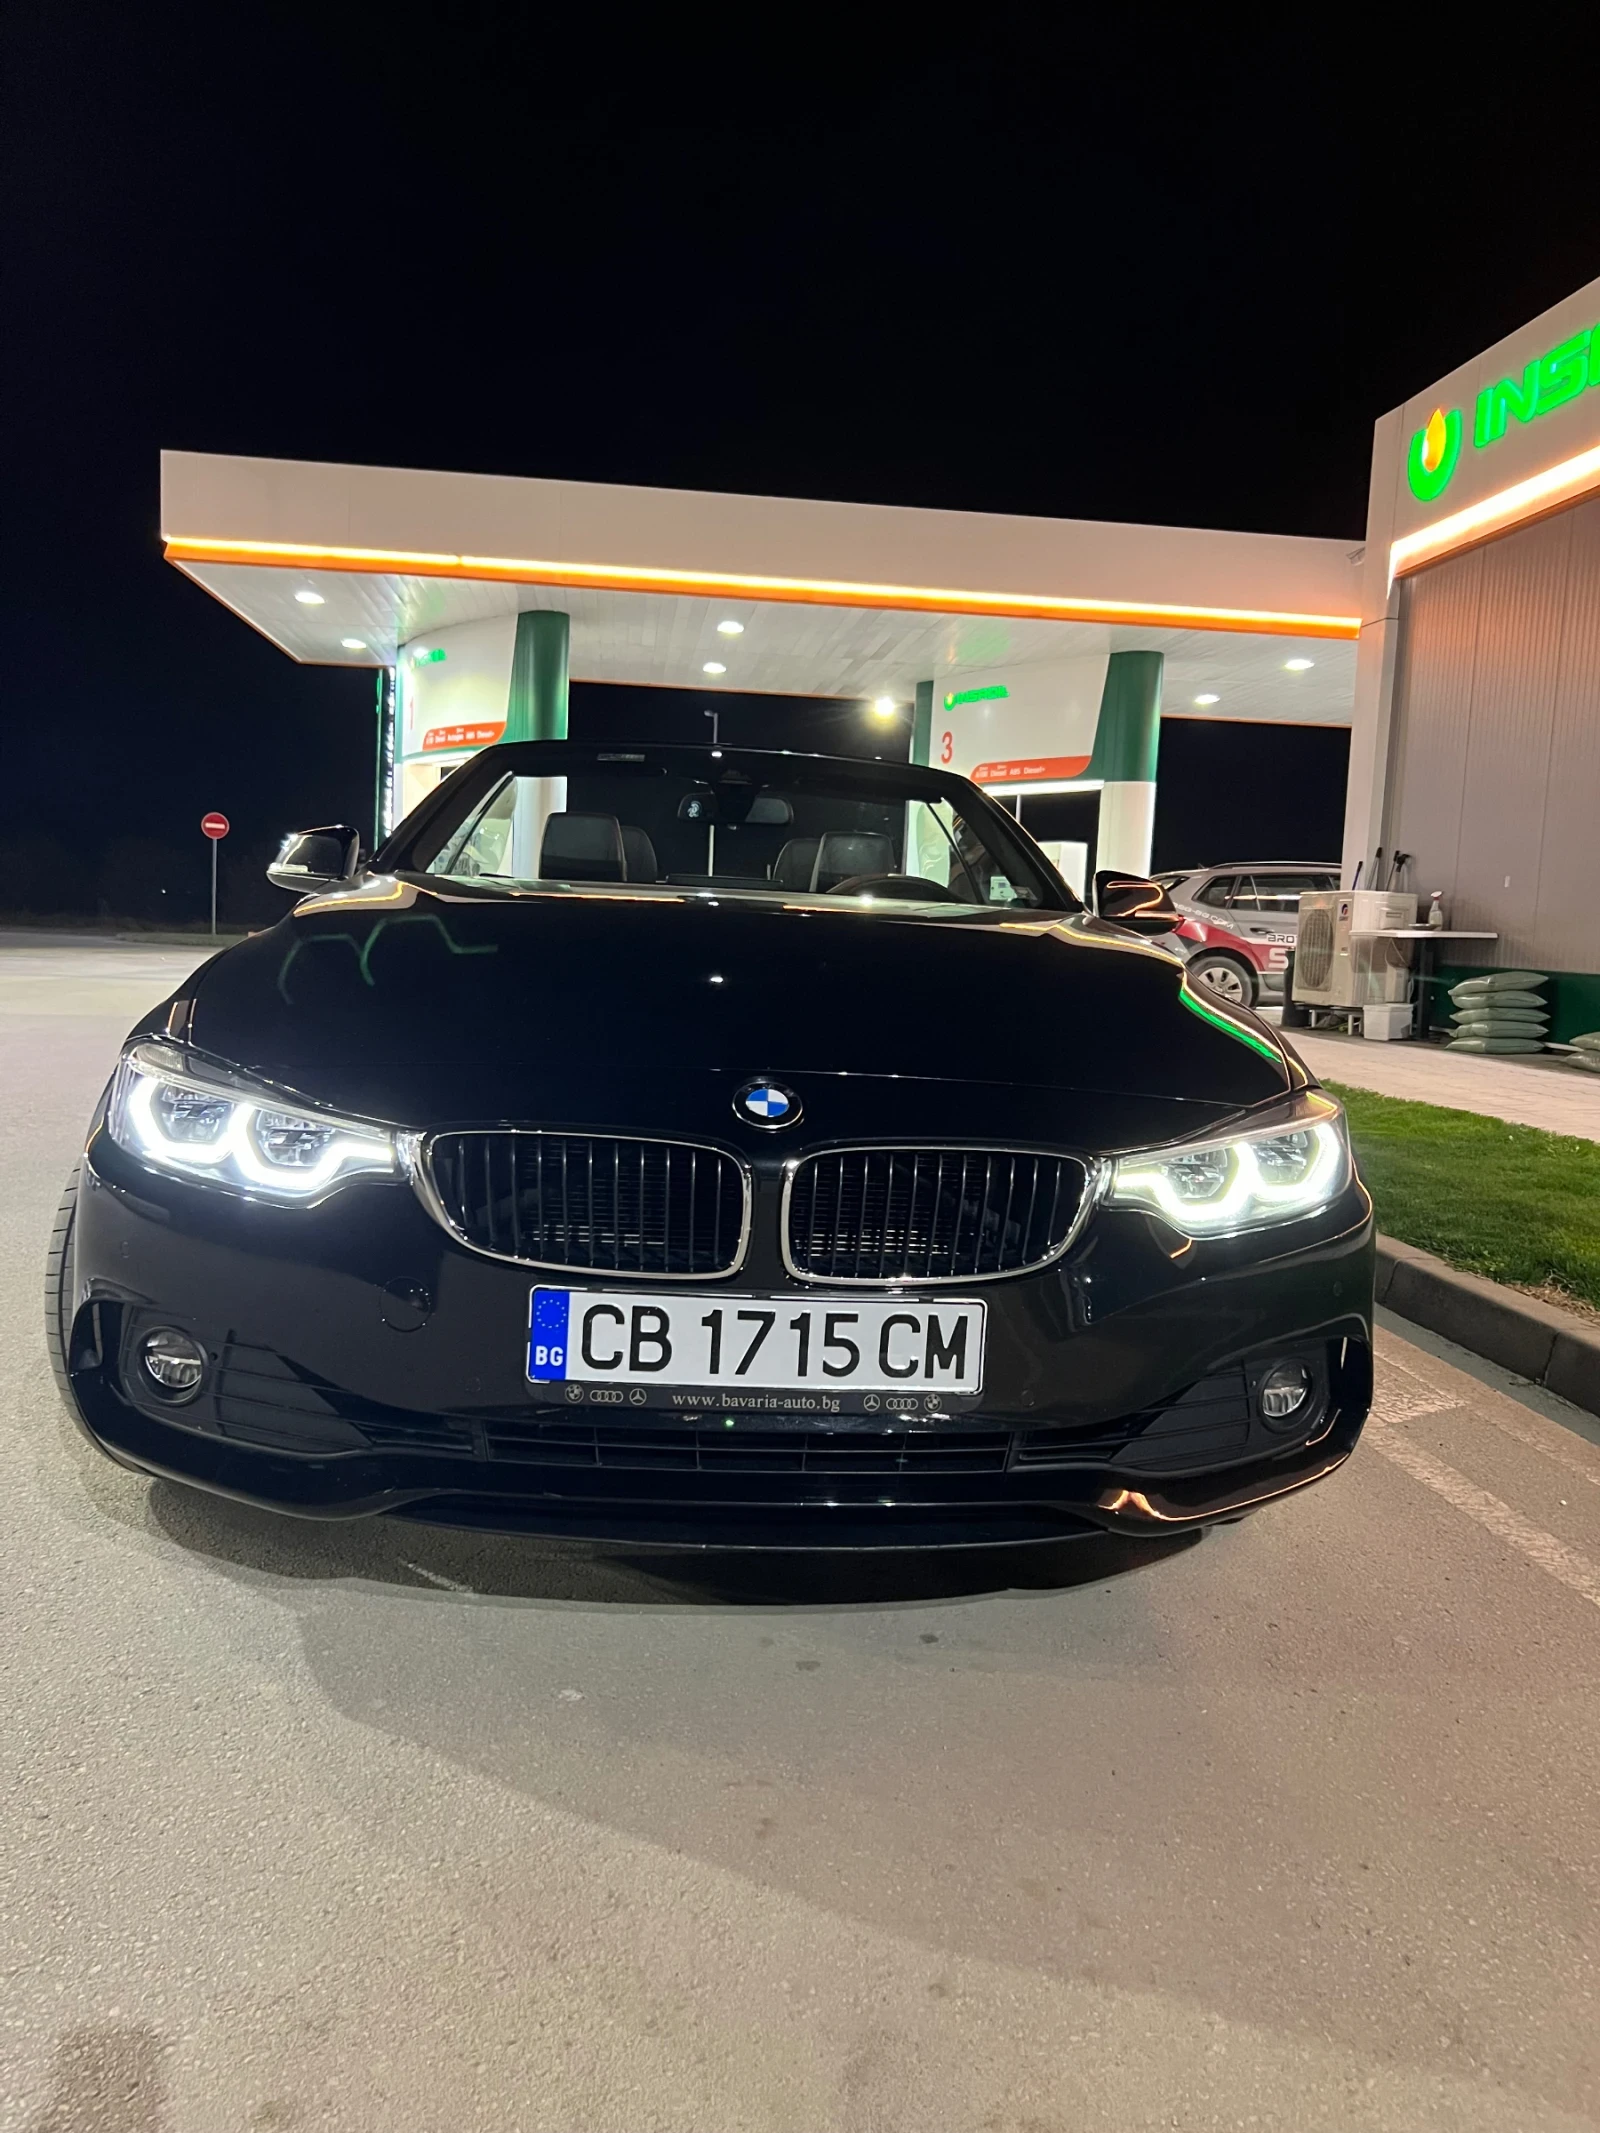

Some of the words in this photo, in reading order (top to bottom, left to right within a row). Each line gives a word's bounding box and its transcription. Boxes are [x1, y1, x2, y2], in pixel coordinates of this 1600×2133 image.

[941, 731, 953, 764] 3
[1267, 934, 1297, 943] BRO
[581, 1304, 672, 1372] CB
[701, 1309, 859, 1378] 1715
[878, 1314, 968, 1379] CM
[535, 1345, 564, 1366] BG
[672, 1393, 841, 1412] www.bavaria-auto.bg
